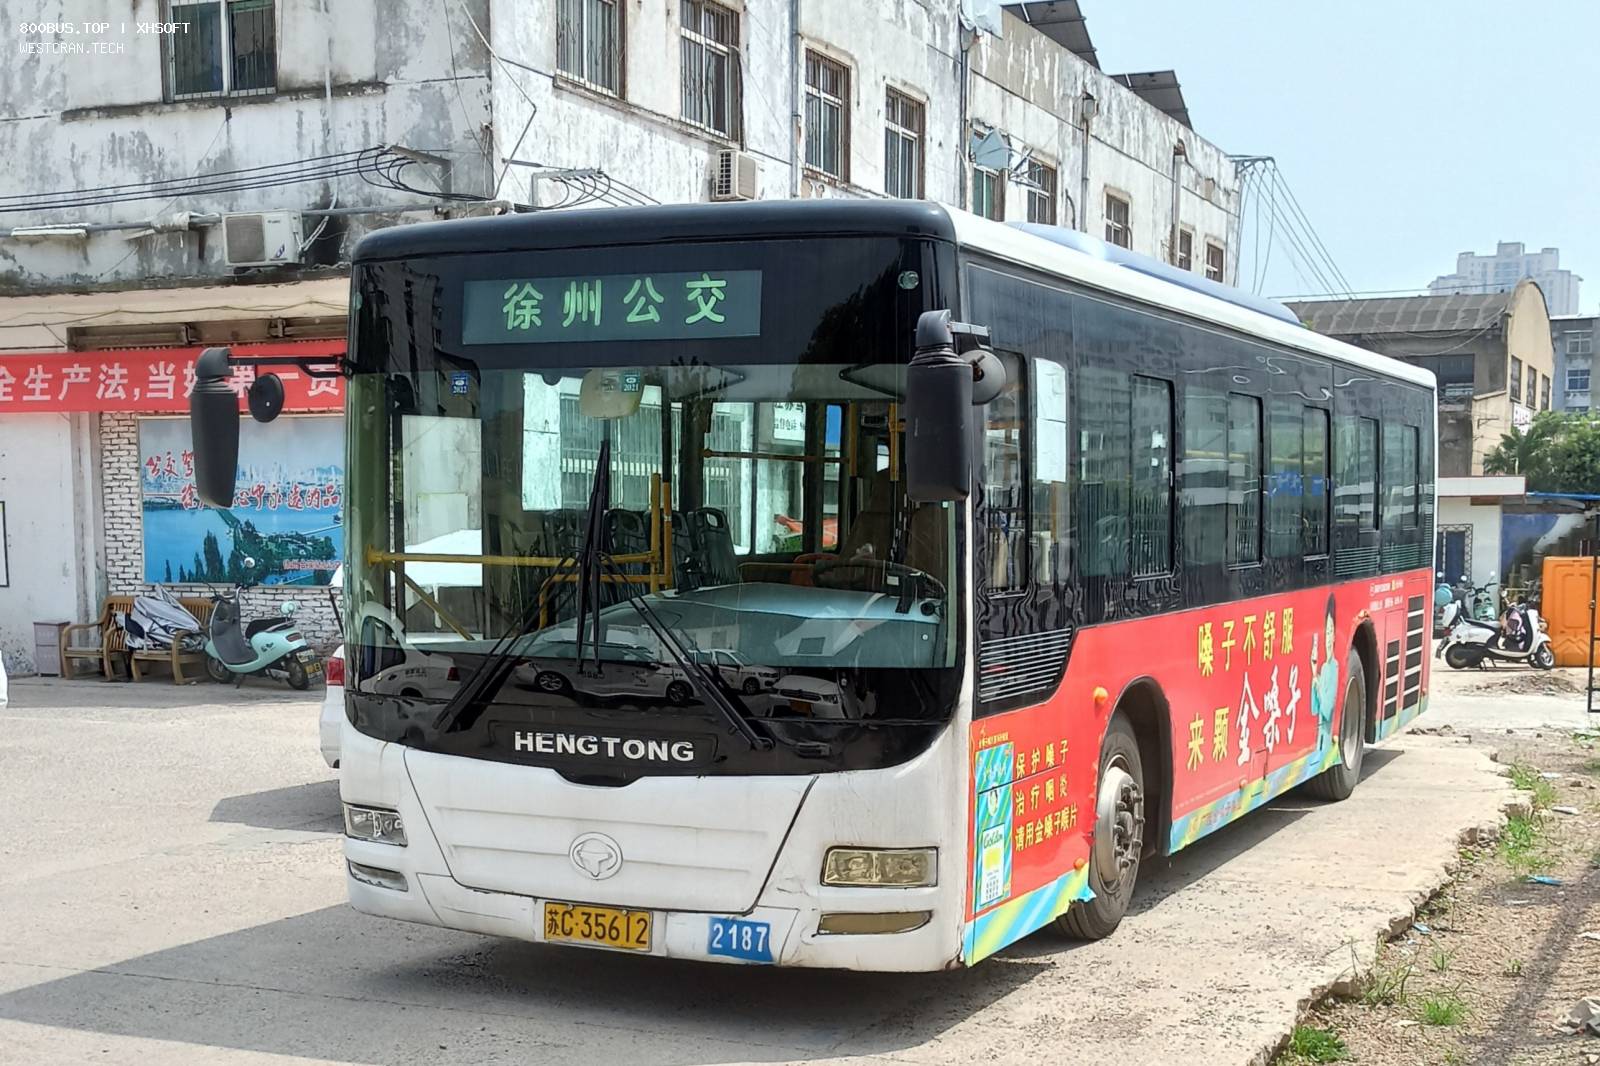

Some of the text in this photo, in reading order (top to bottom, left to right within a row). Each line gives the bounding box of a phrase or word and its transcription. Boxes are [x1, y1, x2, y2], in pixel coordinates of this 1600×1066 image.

[502, 273, 727, 330] 徐州公交
[1198, 607, 1294, 677] 嗓子不舒服
[514, 731, 694, 762] HENGTONG
[1016, 739, 1069, 780] 保护嗓子
[1187, 707, 1230, 772] 来颗
[711, 922, 768, 953] 2187
